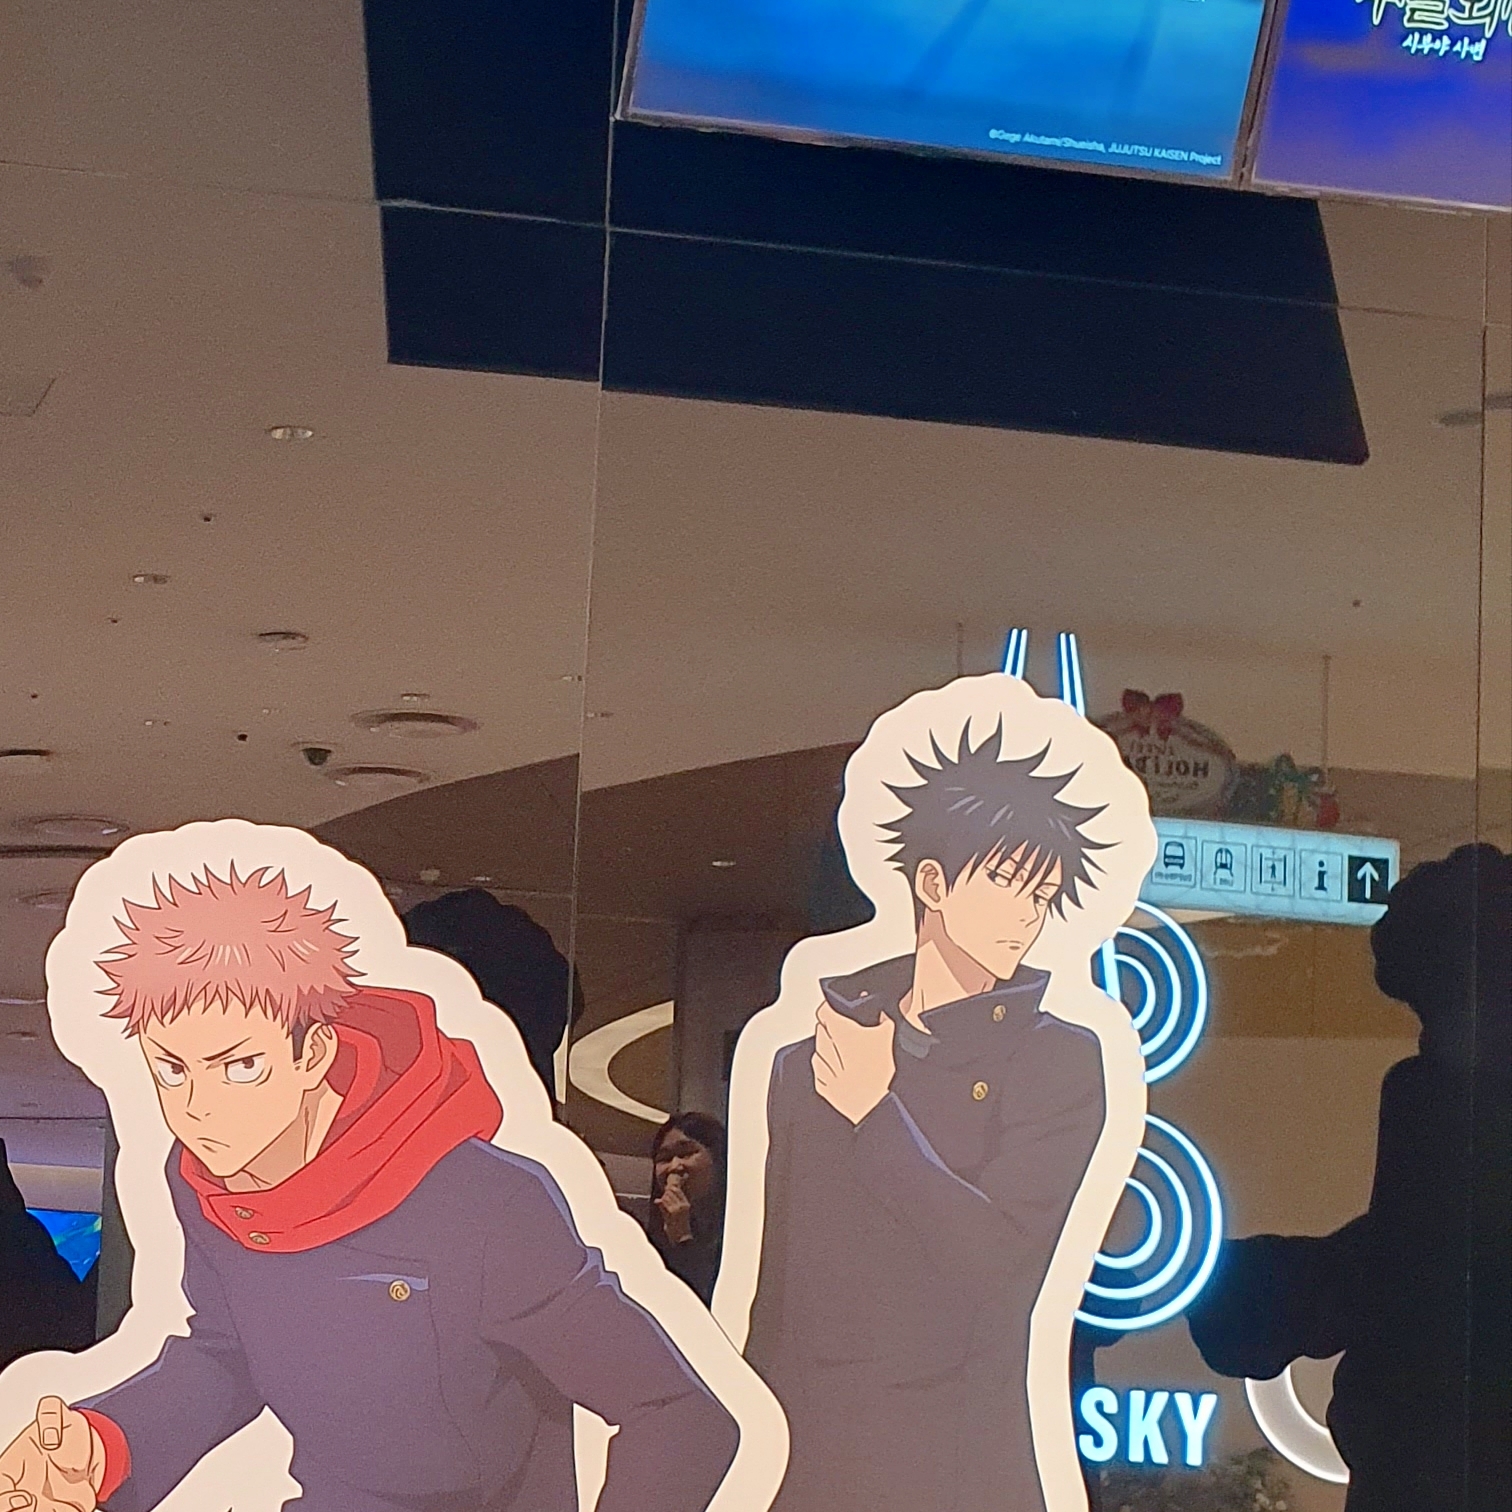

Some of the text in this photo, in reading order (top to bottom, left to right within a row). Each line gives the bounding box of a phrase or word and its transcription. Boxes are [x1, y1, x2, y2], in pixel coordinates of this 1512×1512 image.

[1401, 31, 1487, 62] 시부야 사변
[1154, 147, 1189, 161] KAISEN
[1190, 151, 1222, 165] Project
[1078, 1387, 1218, 1467] SKY
